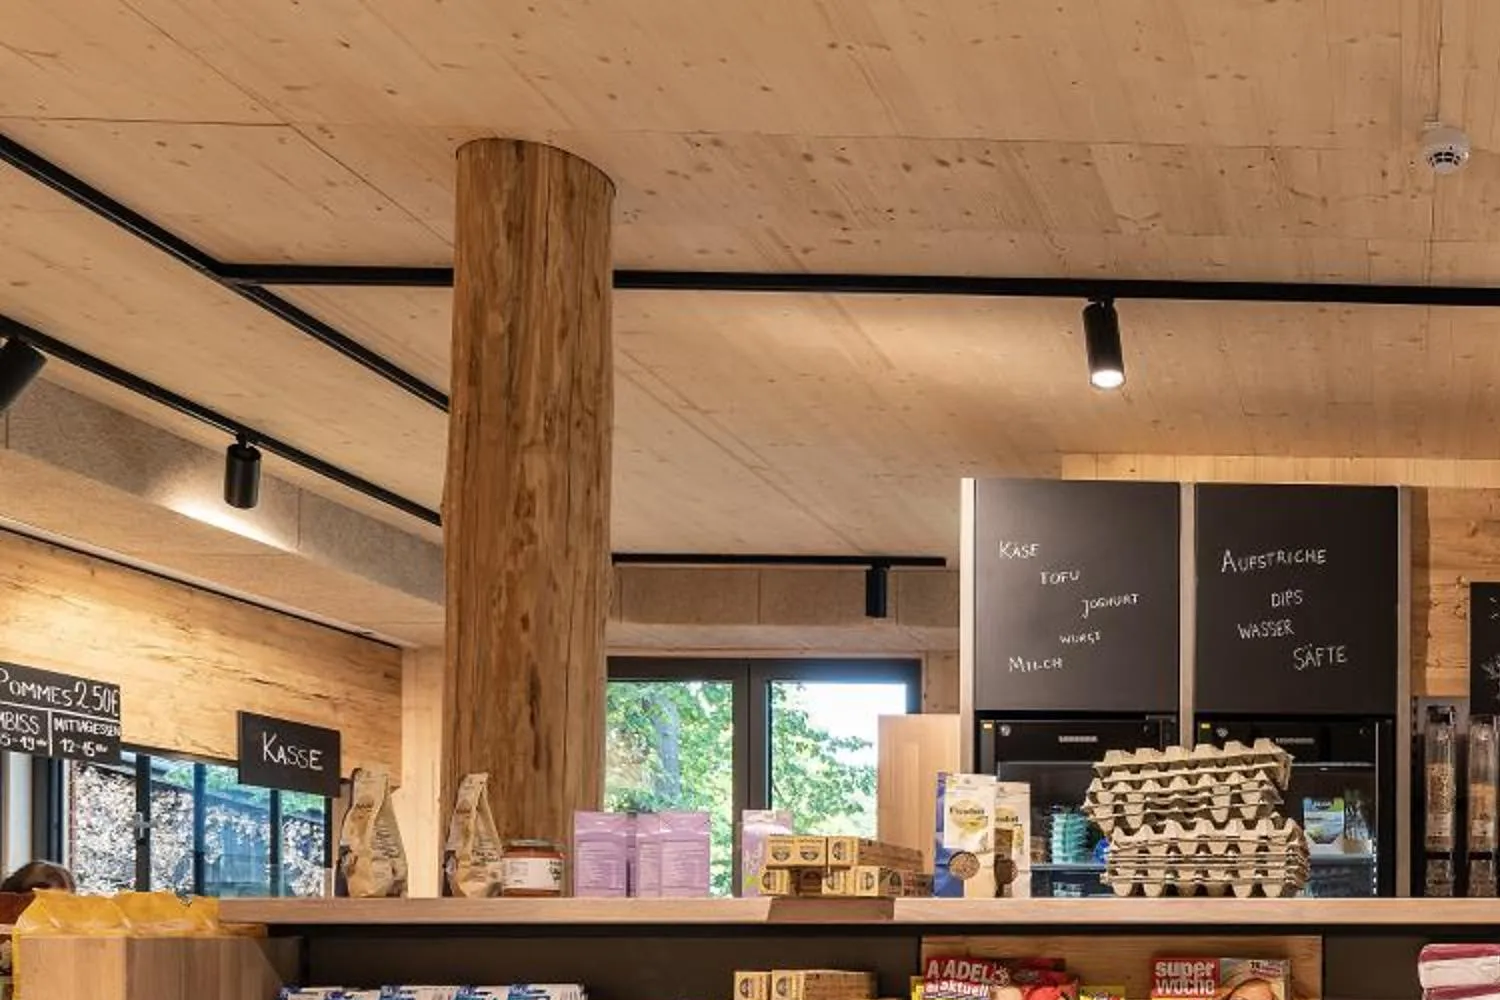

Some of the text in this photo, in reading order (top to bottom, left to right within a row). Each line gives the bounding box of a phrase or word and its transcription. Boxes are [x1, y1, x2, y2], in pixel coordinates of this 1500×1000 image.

[1039, 569, 1081, 585] TOFU
[1271, 589, 1303, 608] DIPS
[1237, 618, 1295, 640] WASSER
[1008, 655, 1063, 673] MILCH
[1293, 642, 1348, 671] SÄFTE
[261, 730, 323, 771] KASSE
